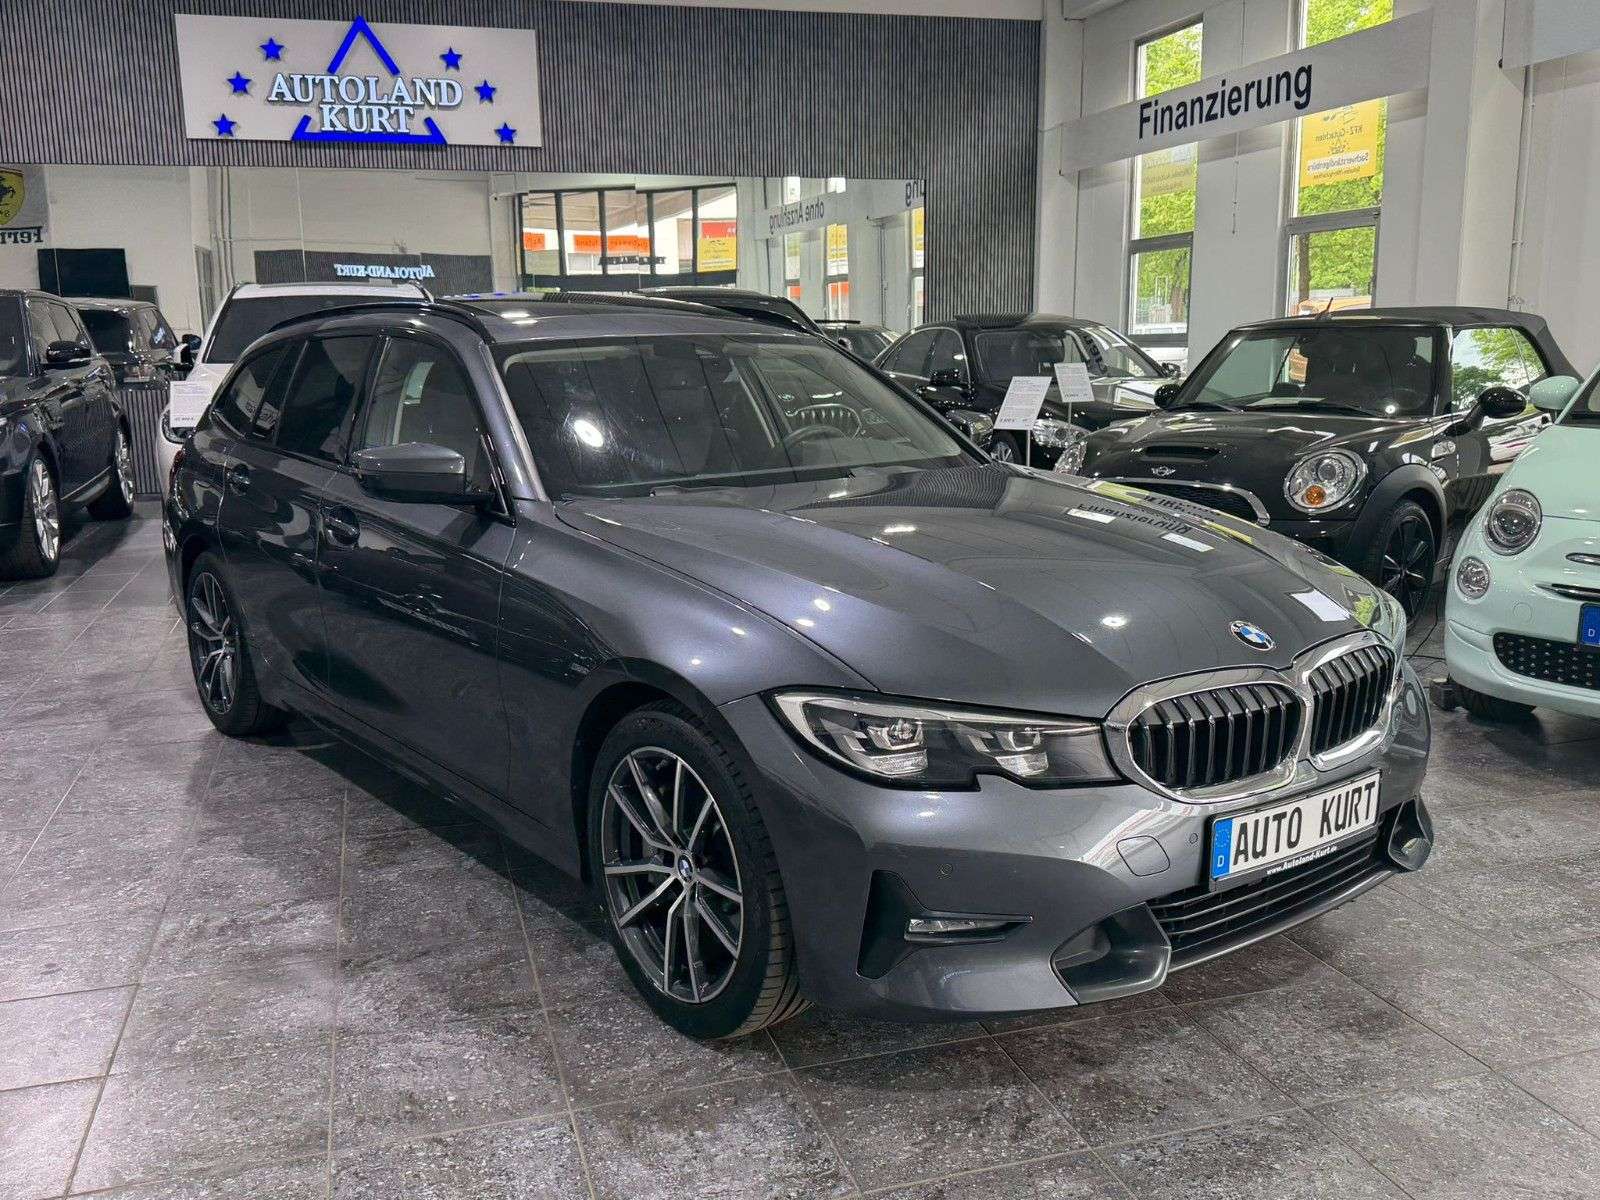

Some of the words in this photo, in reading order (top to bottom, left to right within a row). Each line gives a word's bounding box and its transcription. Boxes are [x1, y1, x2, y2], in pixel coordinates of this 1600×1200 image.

[268, 73, 463, 107] AUTOLAND
[1137, 63, 1313, 140] Finanzierung
[319, 104, 414, 134] KURT
[1588, 628, 1596, 638] D
[1233, 806, 1303, 866] AUTO
[1319, 780, 1376, 838] KURT
[1216, 855, 1225, 868] D
